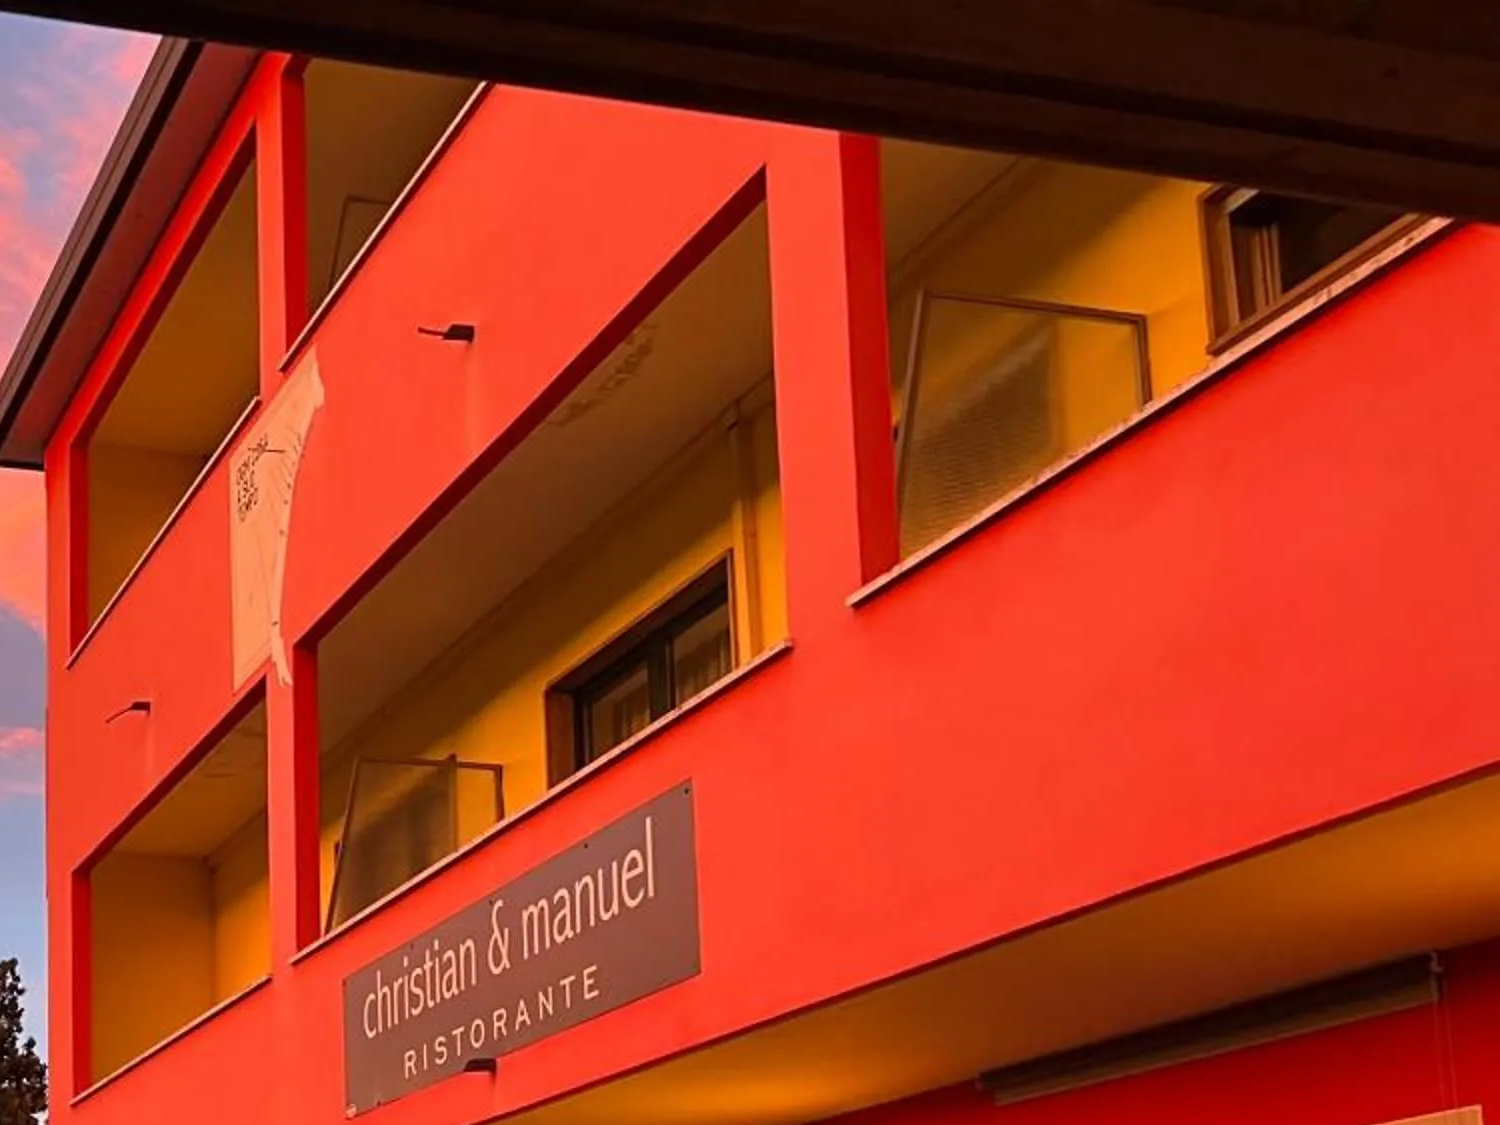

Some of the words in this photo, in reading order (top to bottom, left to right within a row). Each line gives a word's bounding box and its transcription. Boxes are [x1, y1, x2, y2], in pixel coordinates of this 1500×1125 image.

[363, 939, 477, 1038] christian
[488, 899, 511, 974] &
[522, 816, 655, 960] manuel
[404, 965, 599, 1079] RISTORANTE
